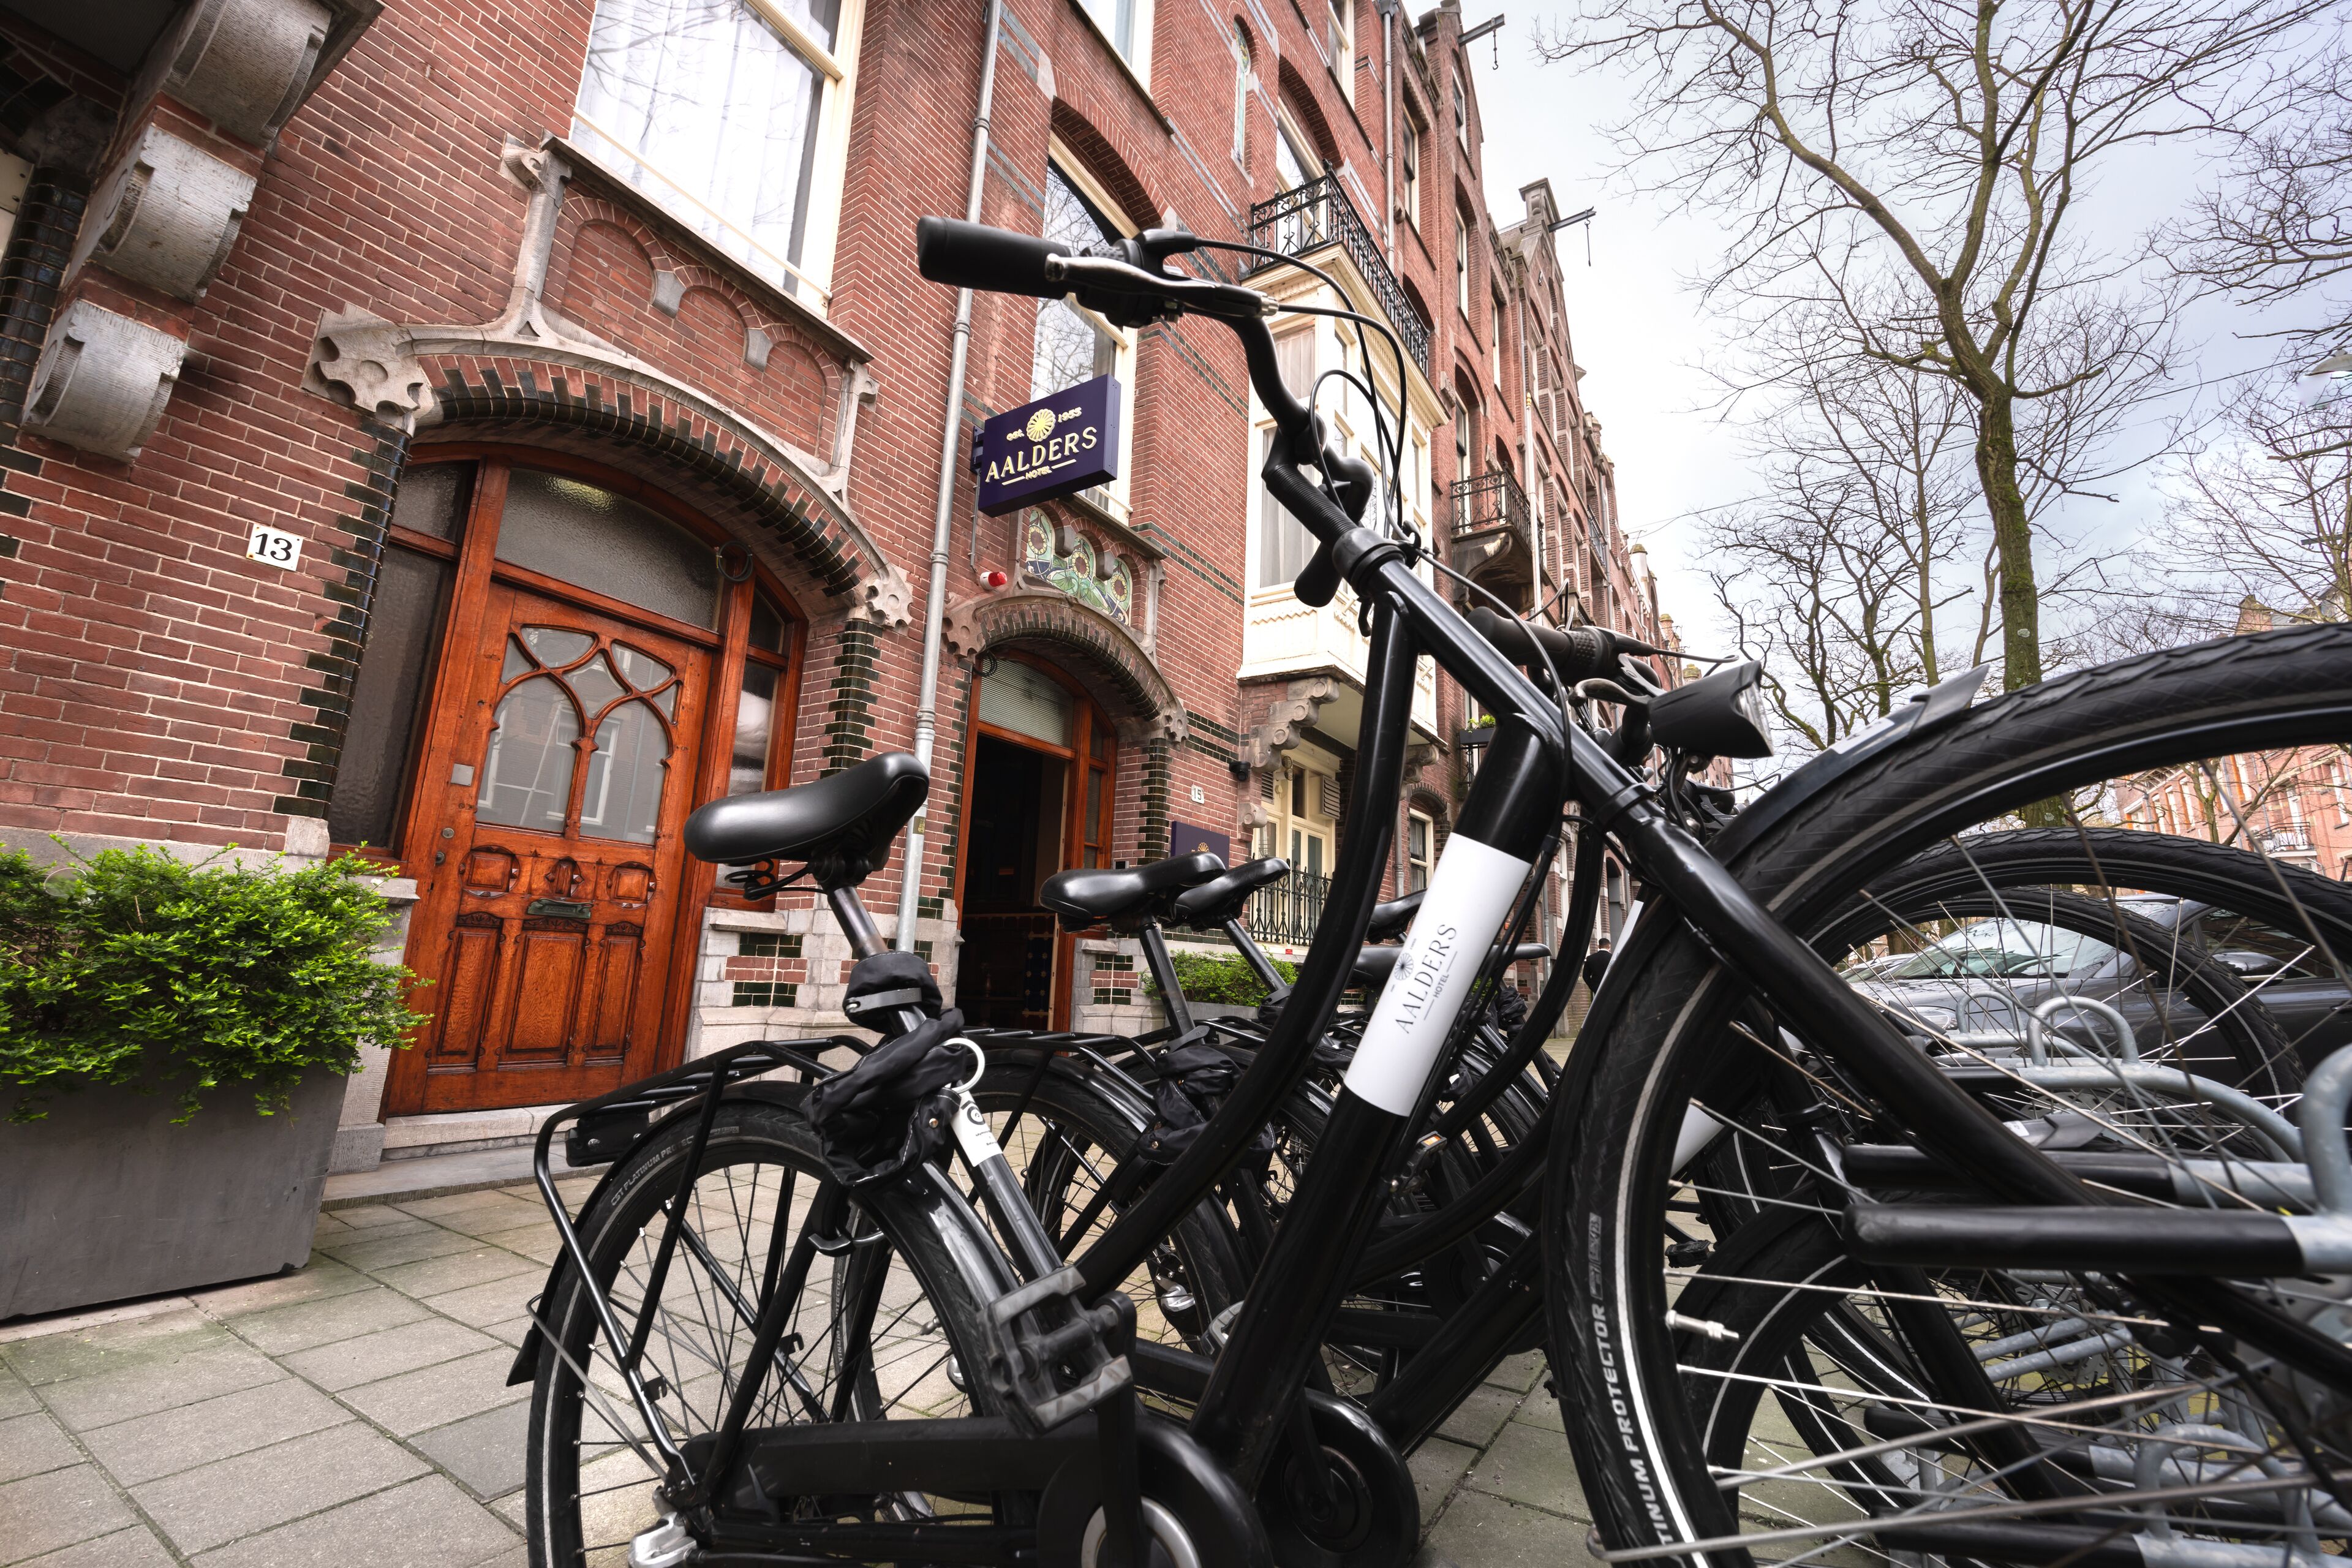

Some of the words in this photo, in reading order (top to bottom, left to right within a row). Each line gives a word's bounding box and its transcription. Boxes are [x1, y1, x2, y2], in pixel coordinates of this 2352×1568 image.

[985, 426, 1097, 483] AALDERS
[1025, 466, 1052, 480] HOTEL
[255, 533, 292, 561] 13
[1194, 788, 1201, 800] 15
[1395, 924, 1457, 1034] AALDERS
[1434, 973, 1450, 998] HOTEL
[611, 1188, 624, 1206] CST
[624, 1153, 660, 1191] PLATINUM
[1591, 1304, 1640, 1453] PROTECTOR
